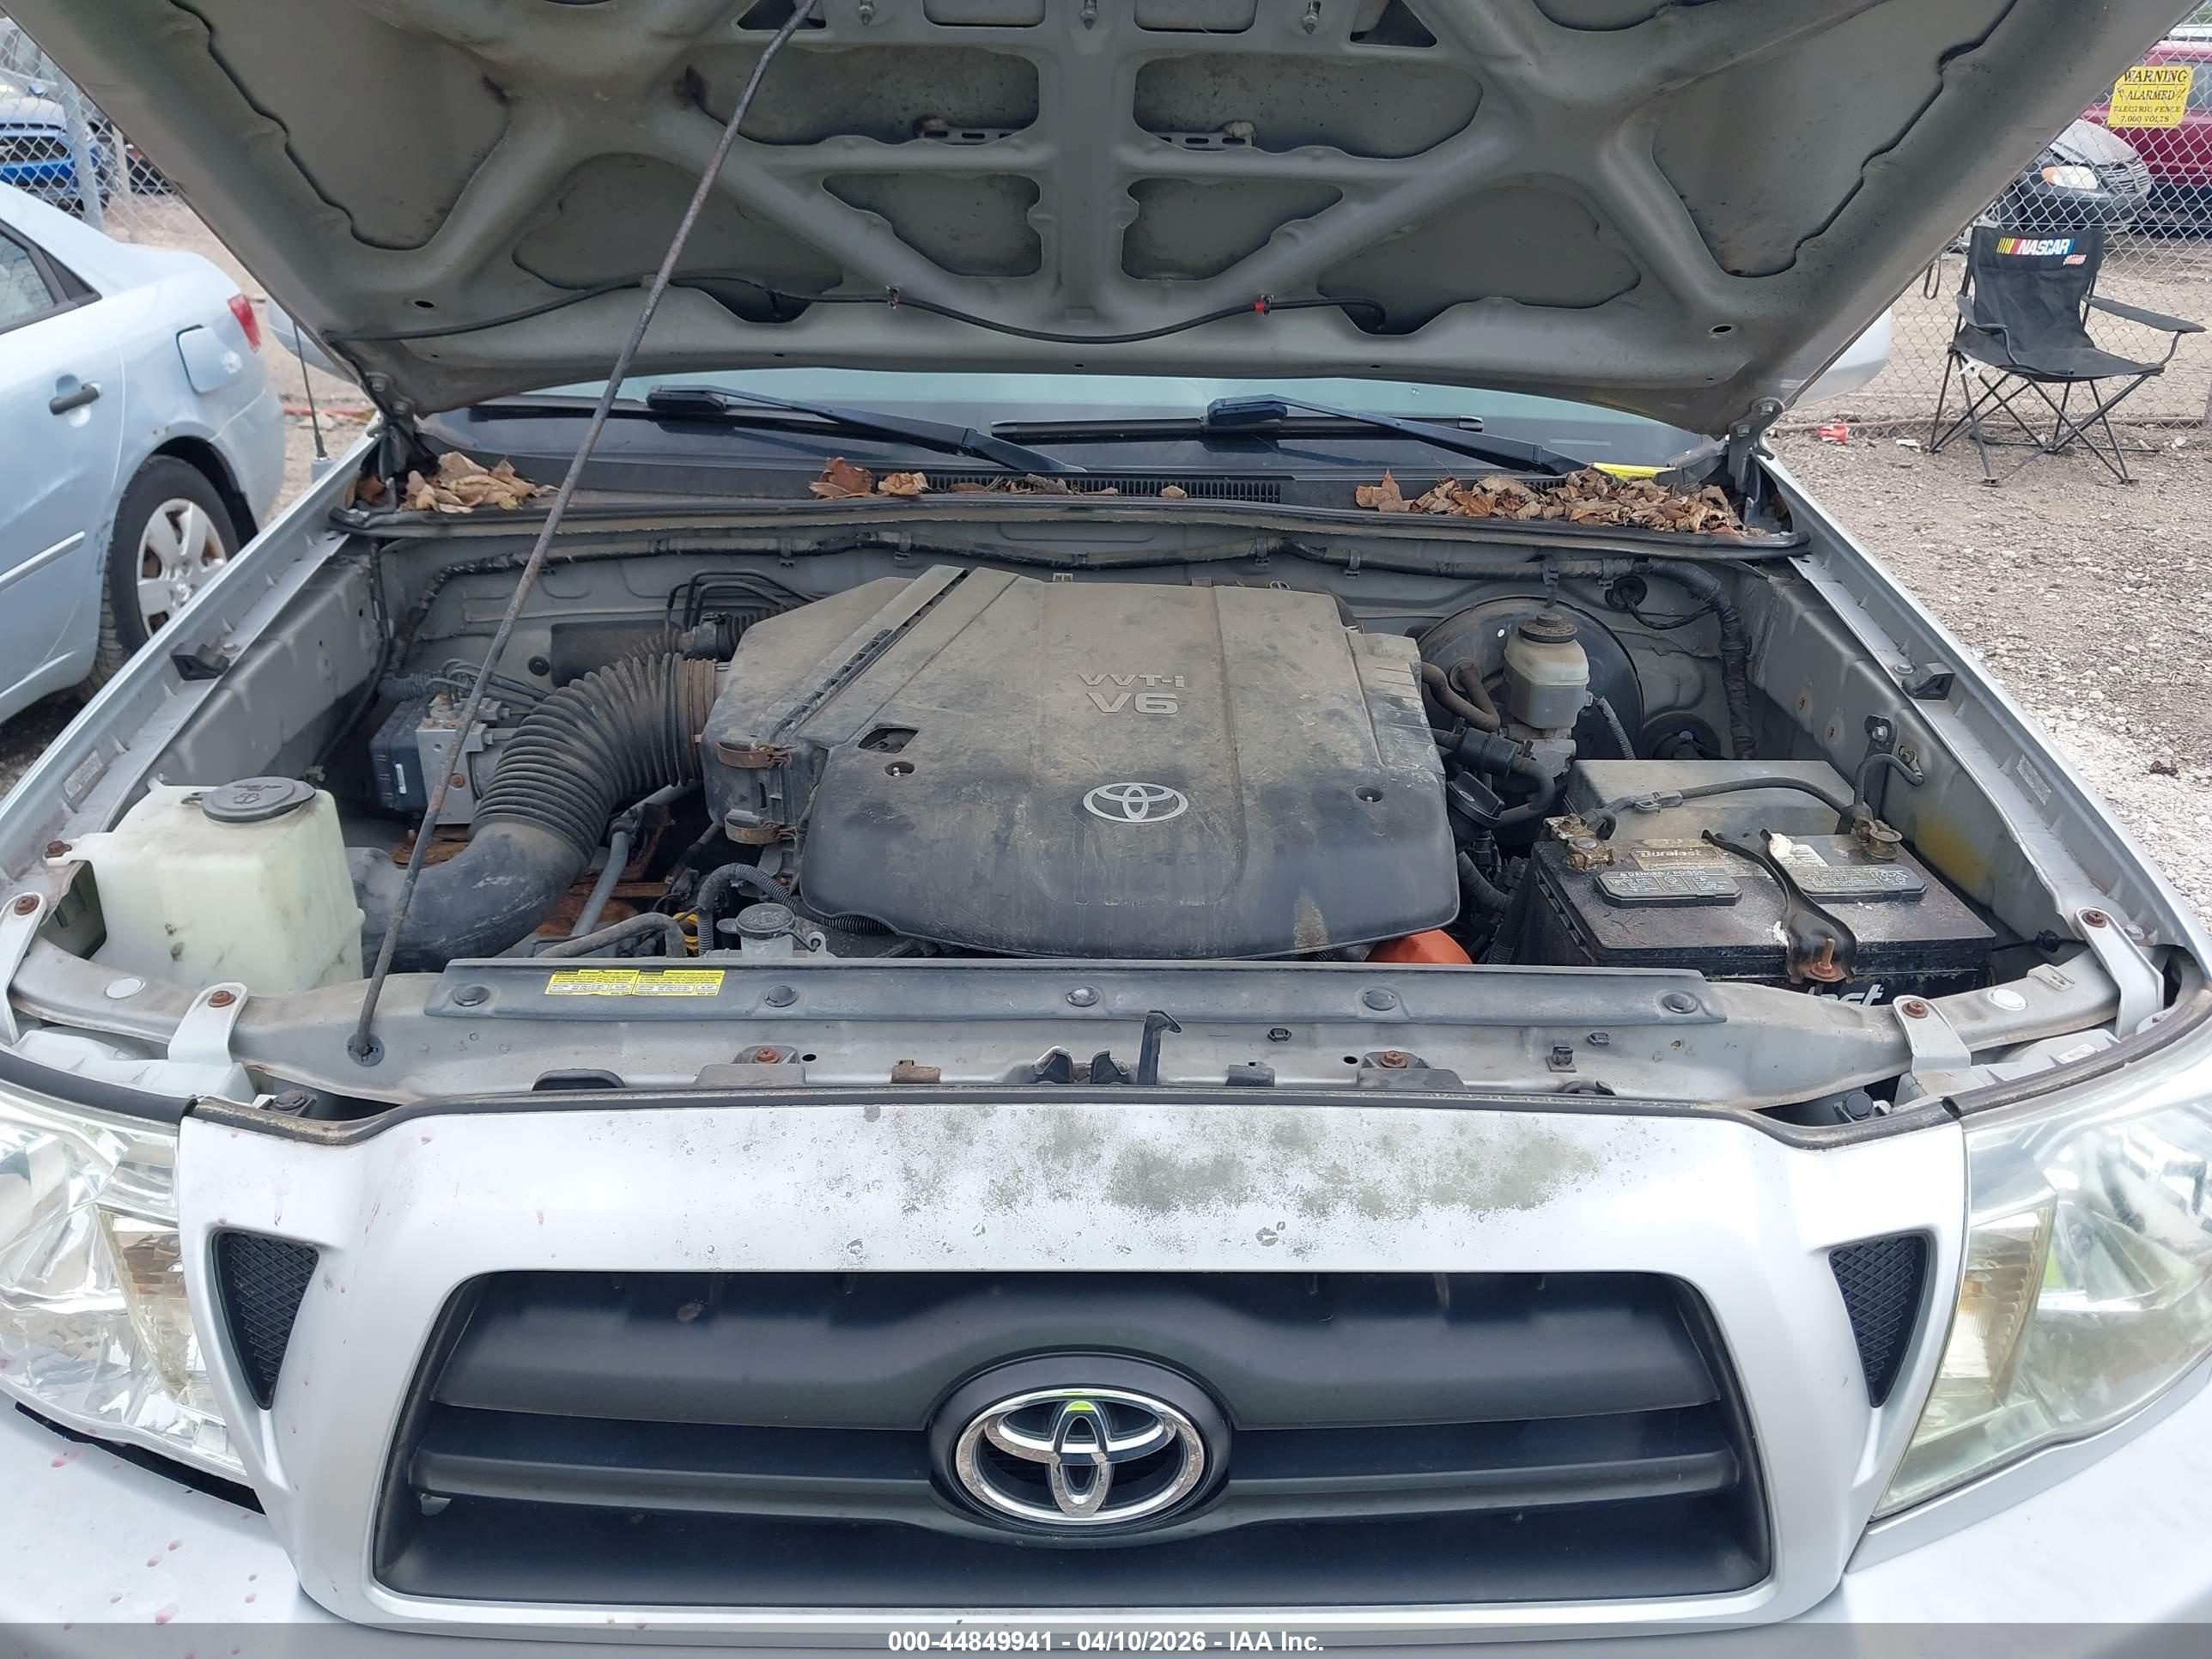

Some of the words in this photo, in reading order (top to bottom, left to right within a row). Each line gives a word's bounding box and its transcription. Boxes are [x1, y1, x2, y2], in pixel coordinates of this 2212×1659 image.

[2124, 70, 2189, 82] WARNING
[2129, 90, 2175, 100] ALARMED
[2017, 239, 2071, 255] NASCAR
[1079, 673, 1185, 688] VVT-i
[1086, 692, 1179, 714] V6
[1636, 848, 1704, 858] Duralast
